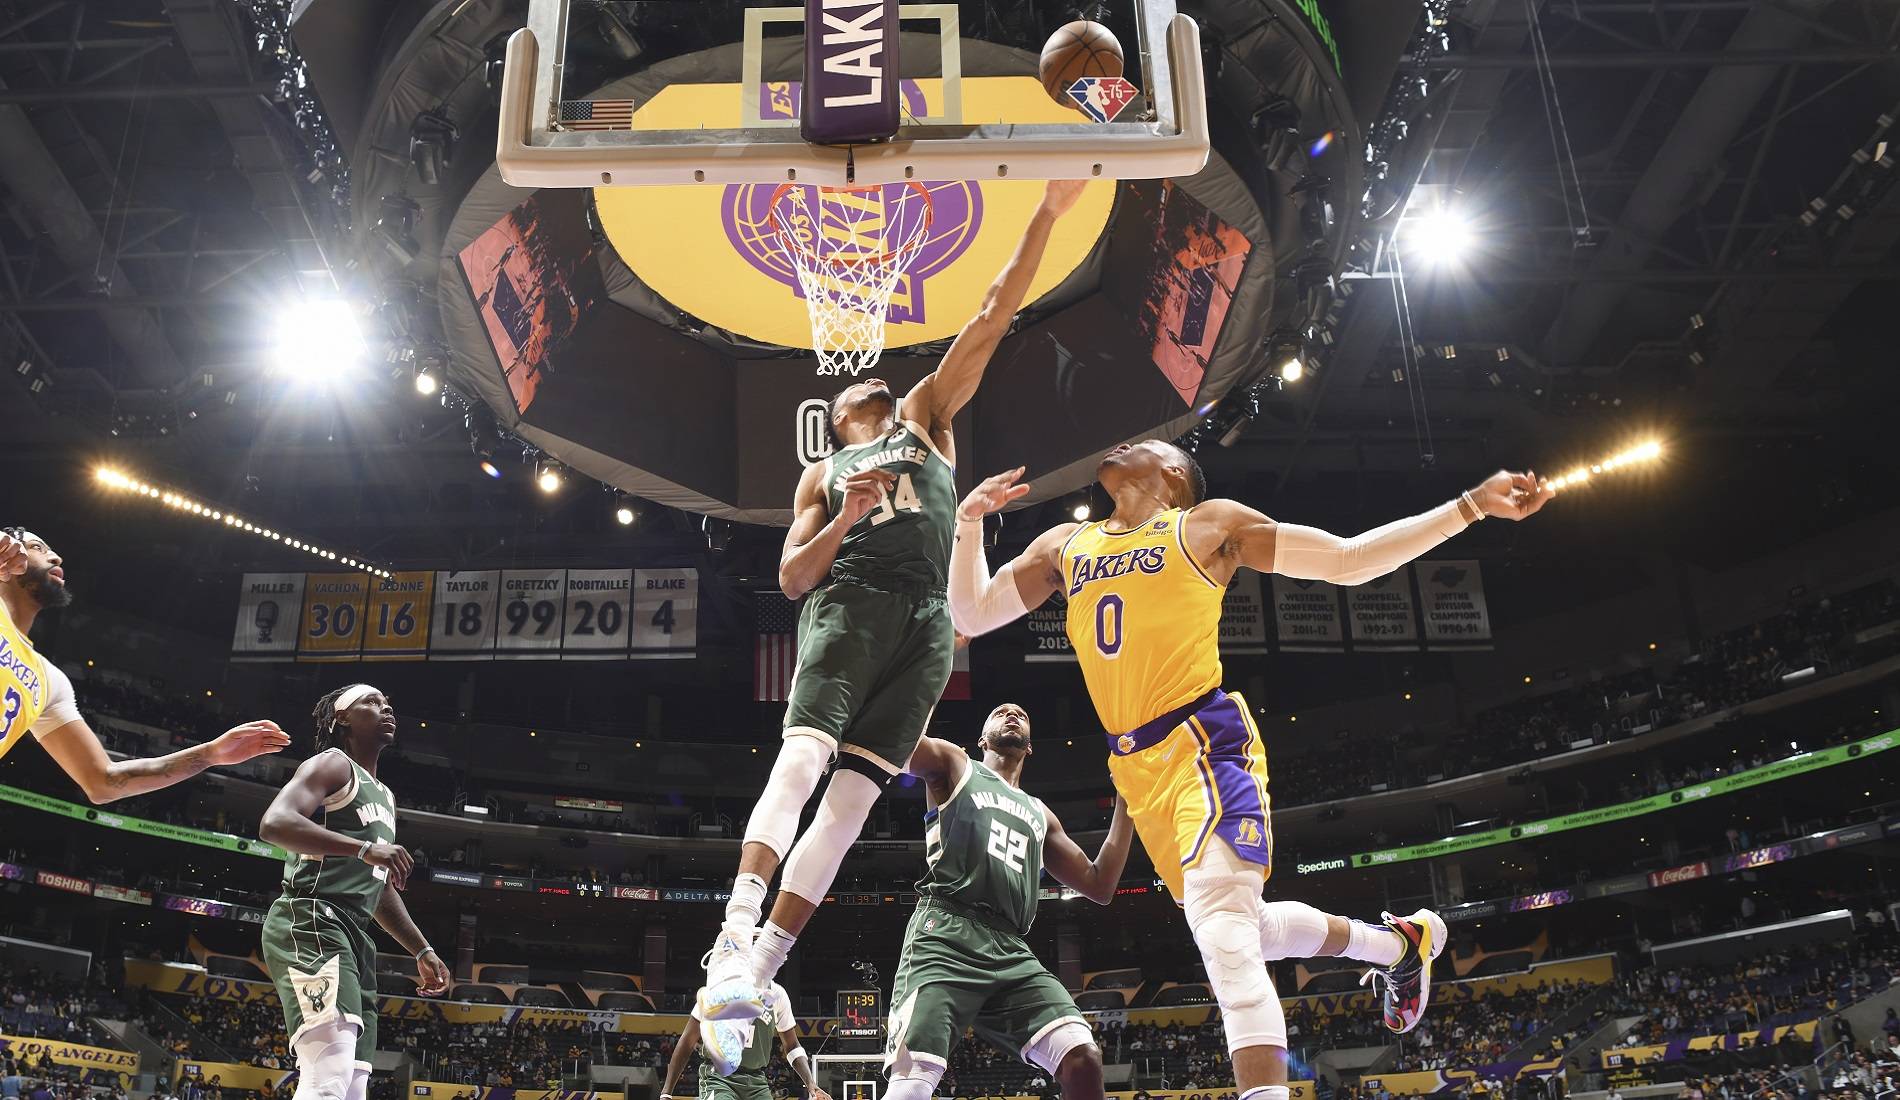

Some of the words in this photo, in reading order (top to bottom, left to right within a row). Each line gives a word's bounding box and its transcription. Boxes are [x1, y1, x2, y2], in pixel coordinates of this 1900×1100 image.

[823, 0, 884, 108] LAK
[1109, 85, 1122, 98] 75
[1068, 545, 1167, 597] LAKERS
[251, 583, 294, 593] MILLER
[314, 583, 360, 593] VACHON
[446, 581, 489, 592] TAYLOR
[506, 579, 559, 591] GRETZKY
[569, 579, 629, 591] ROBITAILLE
[647, 579, 685, 590] BLAKE
[308, 603, 357, 637] 30
[378, 602, 416, 637] 16
[444, 602, 483, 636] 18
[506, 600, 557, 636] 99
[572, 600, 622, 636] 20
[651, 600, 675, 635] 4
[1028, 609, 1065, 621] STANLE
[1095, 593, 1125, 661] 0
[1038, 637, 1072, 650] 2013-
[971, 792, 1044, 843] MILWAUKEE
[987, 817, 1029, 874] 22
[1297, 859, 1345, 875] Spectrum
[38, 871, 91, 892] TOSHIBA
[458, 875, 480, 883] EXPRESS
[577, 883, 589, 891] LAL
[592, 884, 604, 892] MIL
[676, 892, 711, 900] DELTA
[175, 972, 249, 1000] LOS
[847, 994, 874, 1007] 11:39
[55, 1047, 137, 1067] ANGELES
